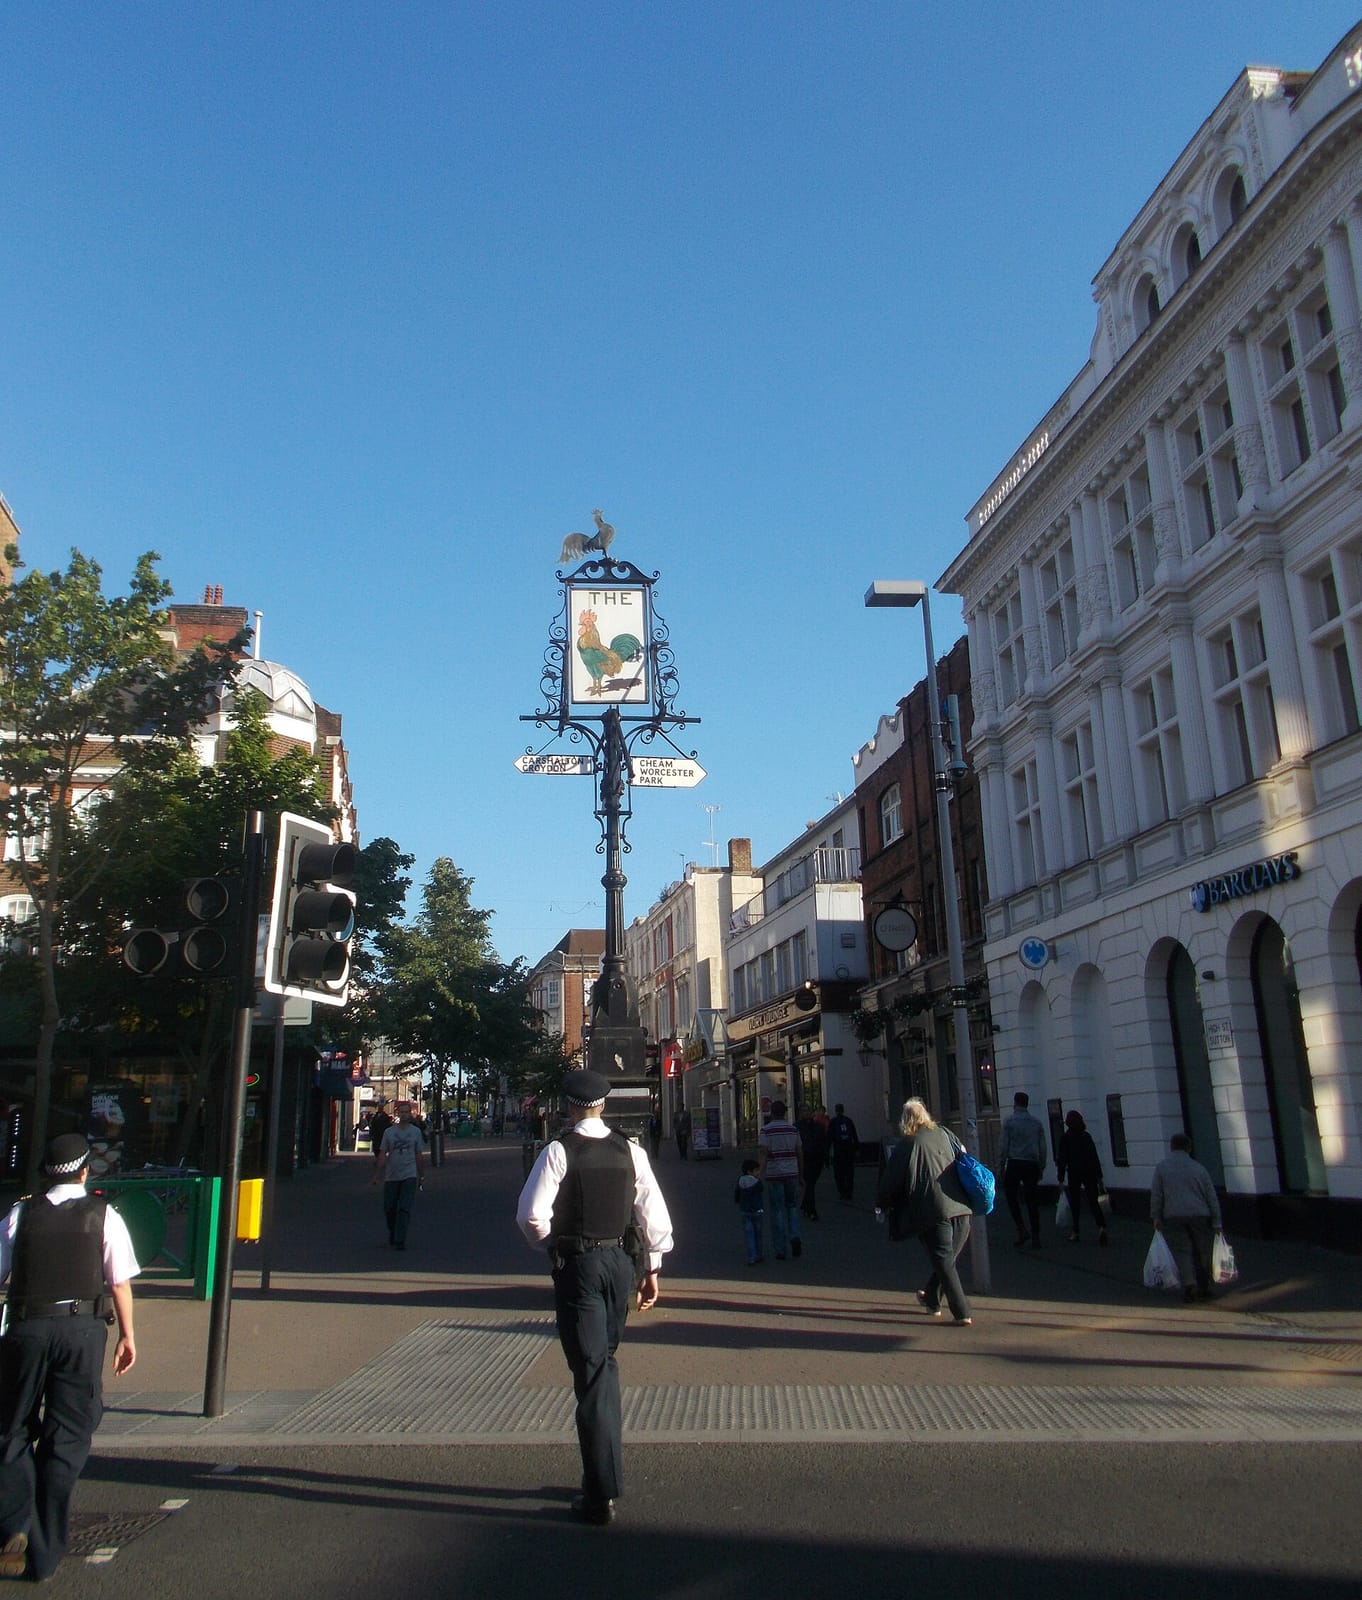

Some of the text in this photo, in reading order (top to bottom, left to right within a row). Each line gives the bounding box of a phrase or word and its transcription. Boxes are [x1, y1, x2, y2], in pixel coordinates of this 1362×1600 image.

[589, 592, 632, 605] THE
[522, 757, 584, 765] CARSHALTON
[639, 759, 673, 768] CHEAM
[522, 764, 566, 772] CROYDON
[639, 768, 694, 777] WORCESTER
[639, 776, 663, 785] PARK
[1207, 852, 1299, 904] BARCLAYS
